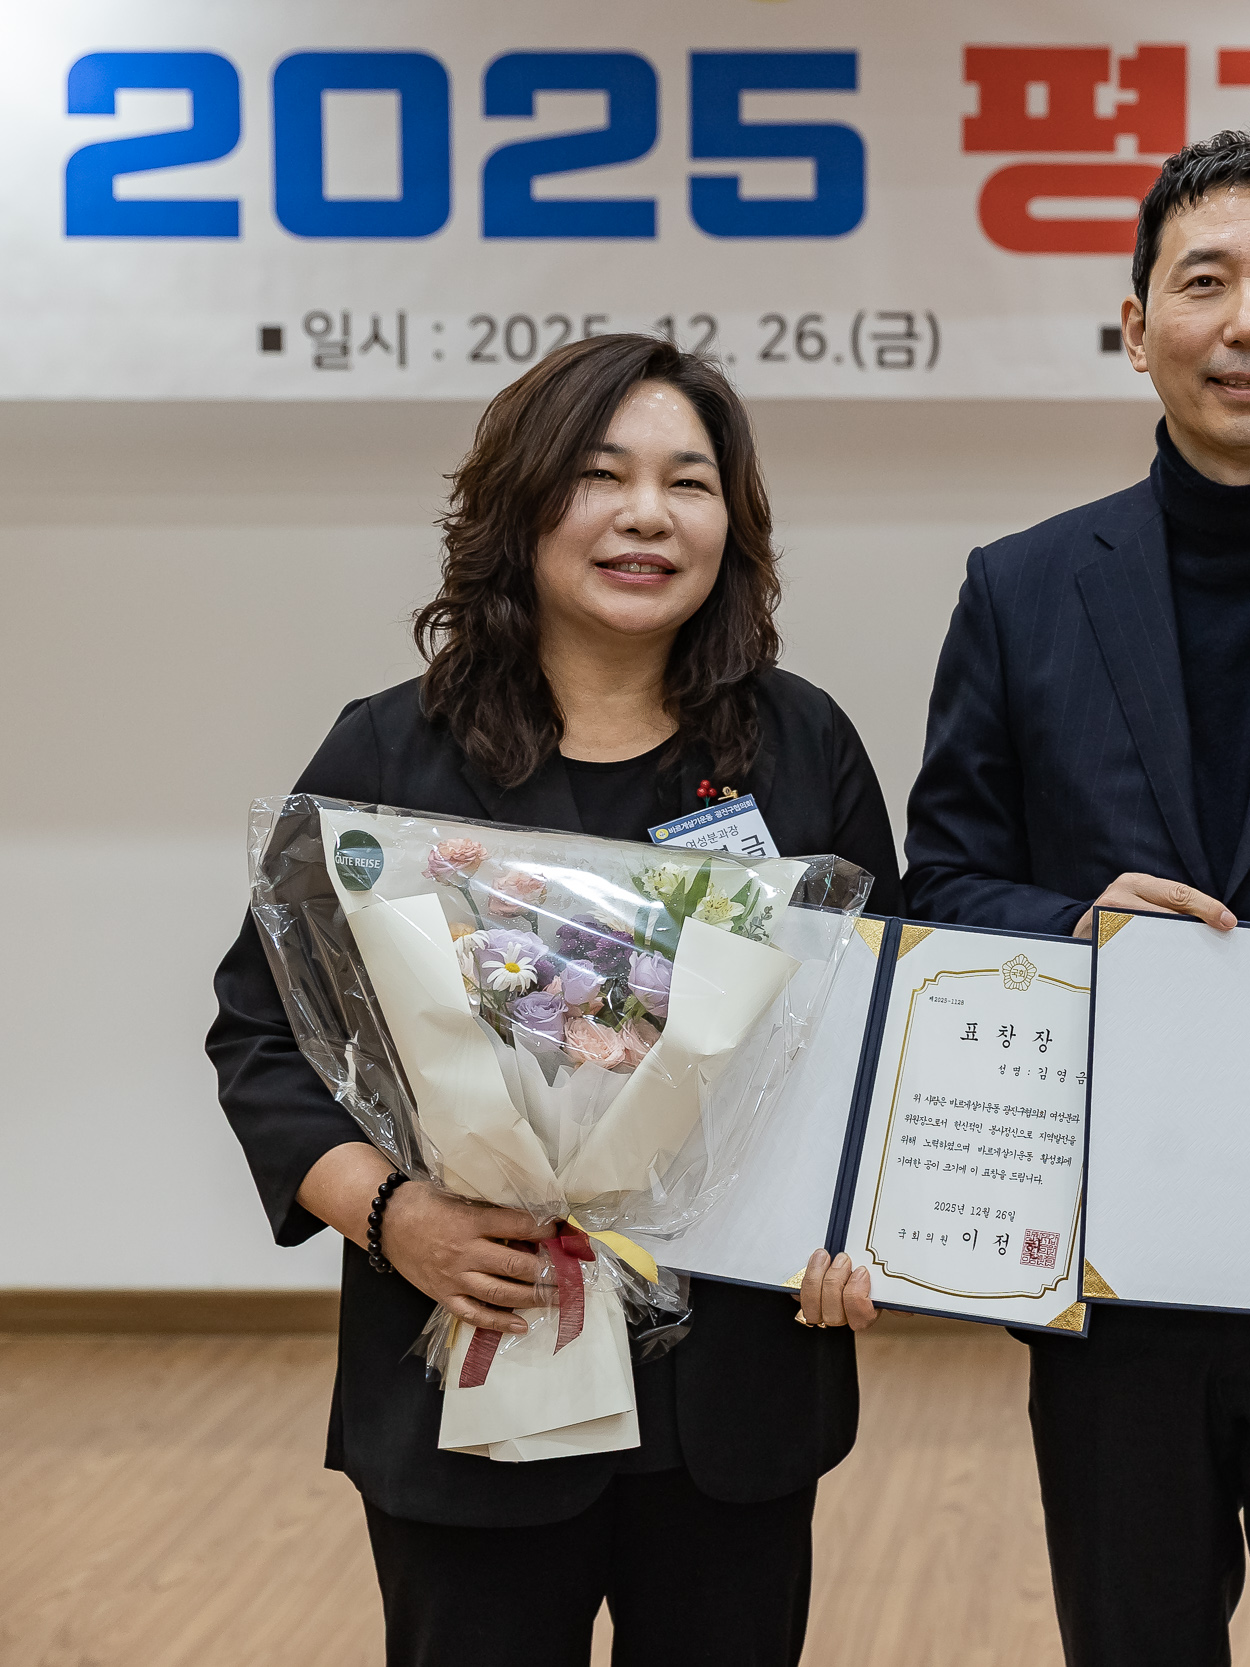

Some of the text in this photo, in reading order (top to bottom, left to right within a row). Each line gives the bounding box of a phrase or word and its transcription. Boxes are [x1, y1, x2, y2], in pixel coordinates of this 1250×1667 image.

[64, 49, 868, 239] 2025
[302, 309, 408, 371] 일시
[759, 309, 942, 372] 26.(금)
[668, 799, 754, 834] 바르게살기운동 광진구협의회
[686, 824, 739, 849] 여성분과장
[355, 857, 381, 869] REISE
[913, 1093, 1080, 1124] 위 사람은 바르게살기운동 광진구협의회 여성분과
[905, 1114, 1077, 1147] 위원장으로서 헌신적인 봉사정신으로 지역발전을
[900, 1135, 1072, 1167] 위해 노력하였으며 바르게살기운동 활성화에
[897, 1156, 1043, 1185] 기여한 공이 크기에 이 표창을 드립니다.
[934, 1201, 1016, 1223] 2025년 12월 26일
